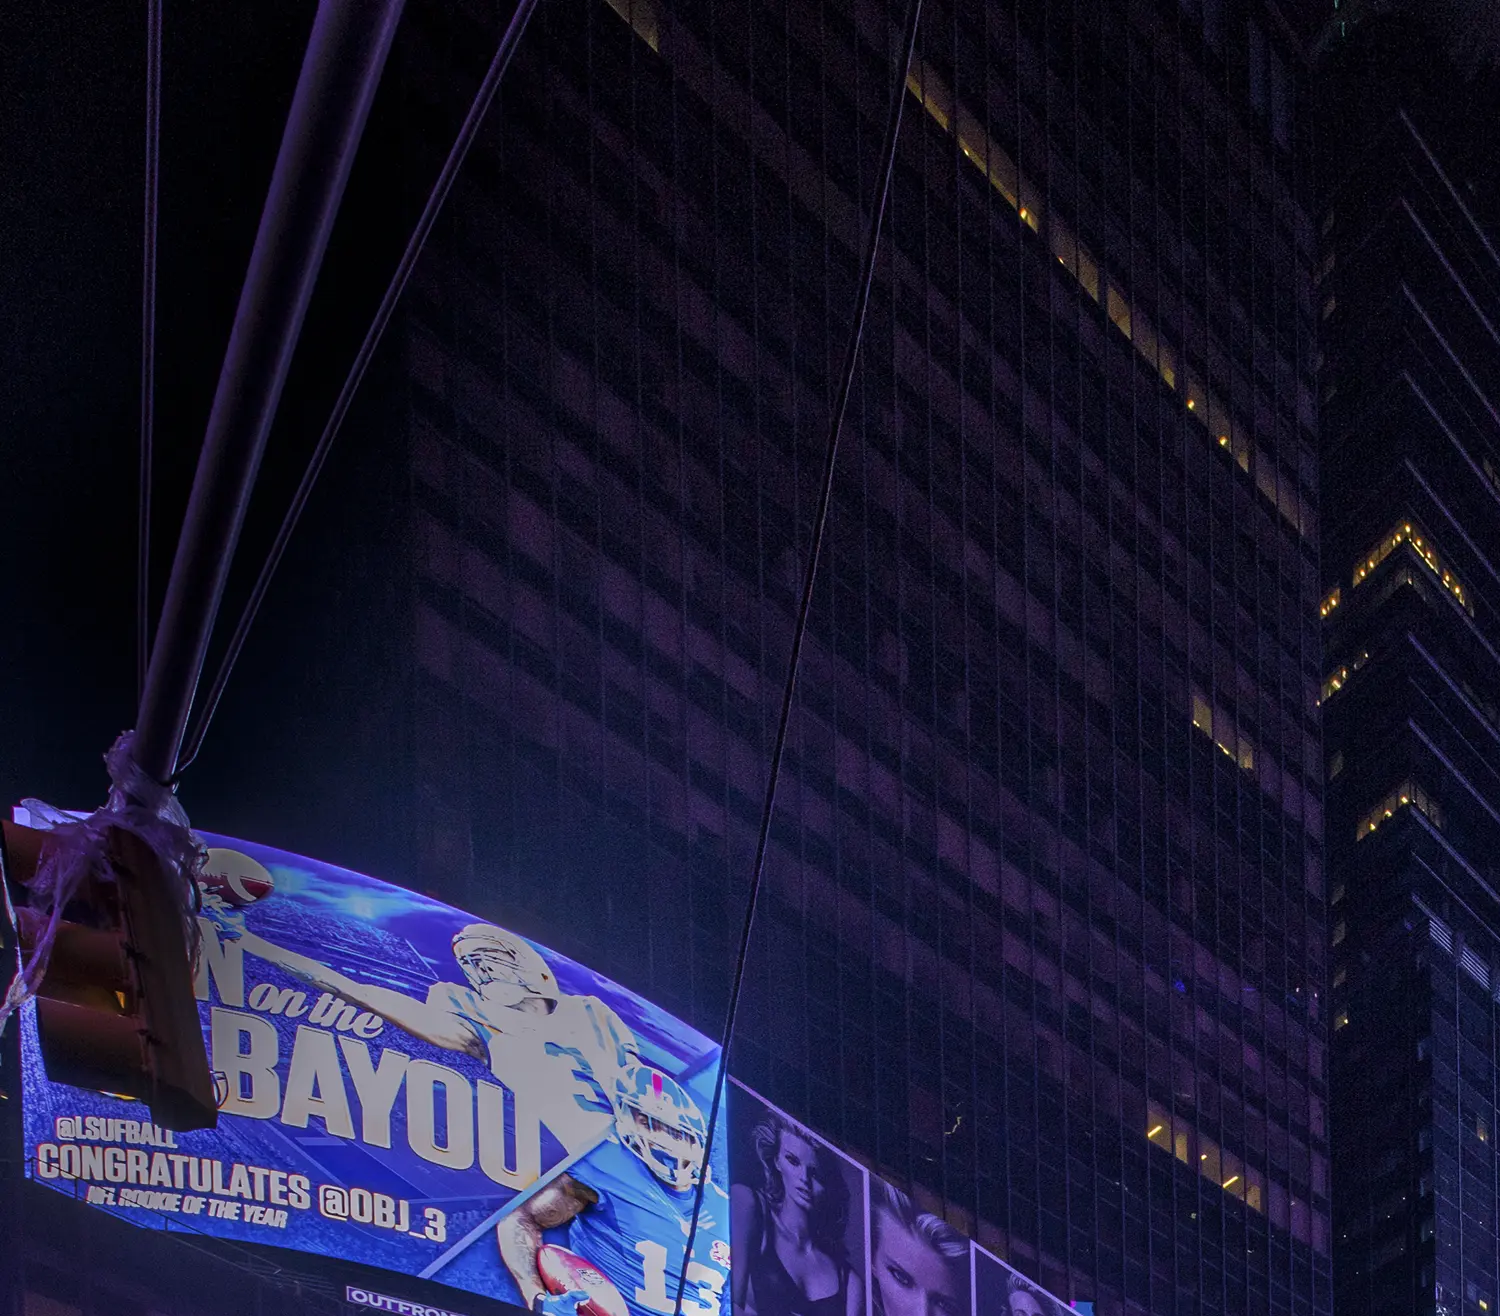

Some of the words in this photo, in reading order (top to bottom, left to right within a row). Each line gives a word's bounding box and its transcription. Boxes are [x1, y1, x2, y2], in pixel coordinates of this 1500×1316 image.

[250, 983, 309, 1019] on
[309, 991, 385, 1040] the
[211, 1006, 541, 1193] BAYOU
[37, 1143, 312, 1210] CONGRATULATES
[319, 1183, 447, 1243] @OBJ_3
[182, 1194, 207, 1215] OF
[208, 1198, 240, 1220] THE
[243, 1203, 288, 1229] YEAR
